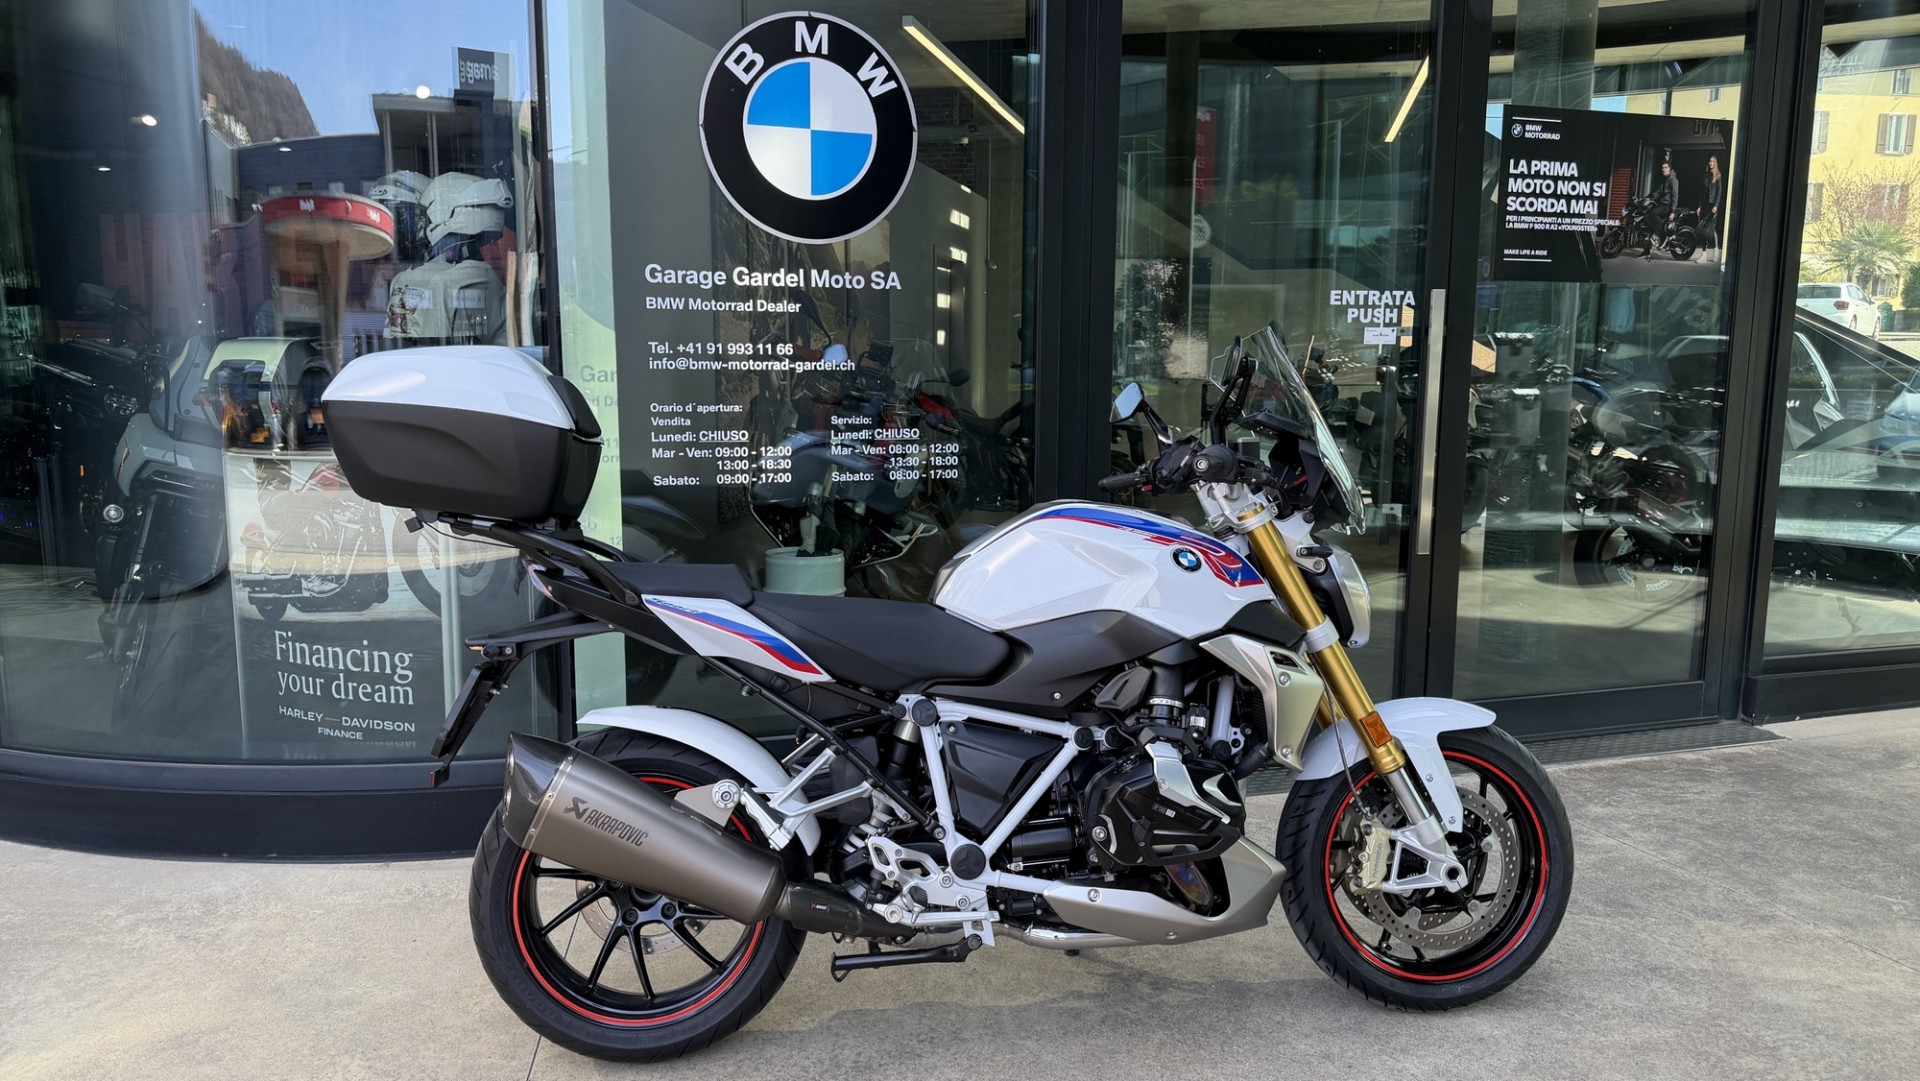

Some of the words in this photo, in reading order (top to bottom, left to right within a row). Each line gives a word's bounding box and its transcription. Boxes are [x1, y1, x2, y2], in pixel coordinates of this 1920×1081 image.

[724, 20, 898, 98] BMW
[1525, 124, 1542, 132] BMW
[1525, 132, 1560, 140] MOTORRAD
[1509, 159, 1528, 175] LA
[1531, 160, 1578, 177] PRIMA
[1508, 178, 1554, 194] MOTO
[1557, 180, 1591, 196] NON
[1593, 182, 1606, 197] SI
[1506, 196, 1568, 213] SCORDA
[1570, 199, 1598, 215] MAI
[645, 263, 727, 289] Garage
[732, 266, 804, 288] Gardel
[810, 269, 865, 289] Moto
[870, 271, 902, 290] SA
[646, 297, 685, 310] BMW
[688, 298, 753, 312] Motorrad
[757, 300, 802, 313] Dealer
[1330, 290, 1416, 306] ENTRATA
[1347, 308, 1398, 324] PUSH
[648, 341, 673, 354] Tel.
[677, 342, 701, 354] +41
[706, 342, 723, 354] 91
[727, 343, 753, 355] 993
[756, 343, 773, 355] 11
[776, 343, 794, 356] 66
[649, 357, 856, 373] info@bmw-motorrad-gardel.ch
[650, 403, 683, 413] Orario
[651, 417, 691, 426] Vendita
[831, 415, 872, 425] Servizio:
[651, 431, 697, 442] Lunedì:
[699, 430, 749, 443] CHIUSO
[831, 429, 872, 440] Lunedì:
[874, 428, 920, 440] CHIUSO
[652, 448, 675, 458] Mar
[686, 447, 712, 458] Ven:
[715, 446, 749, 458] 09:00
[760, 446, 792, 457] 12:00
[831, 445, 853, 455] Mar
[862, 444, 886, 455] Ven:
[888, 444, 920, 454] 08:00
[930, 443, 959, 454] 12:00
[717, 459, 749, 471] 13:00
[761, 459, 792, 470] 18:30
[890, 457, 920, 467] 13:30
[930, 456, 959, 466] 18:00
[653, 475, 700, 486] Sabato:
[716, 474, 749, 485] 09:00
[761, 473, 792, 483] 17:00
[831, 471, 874, 482] Sabato:
[889, 470, 920, 480] 08:00
[929, 469, 958, 479] 17:00
[274, 630, 413, 684] Financing
[277, 671, 325, 696] your
[331, 673, 414, 705] dream
[279, 705, 323, 722] HARLEY
[342, 716, 416, 732] DAVIDSON
[318, 727, 363, 740] FINANCE
[584, 809, 649, 847] AKRAPOVIC
